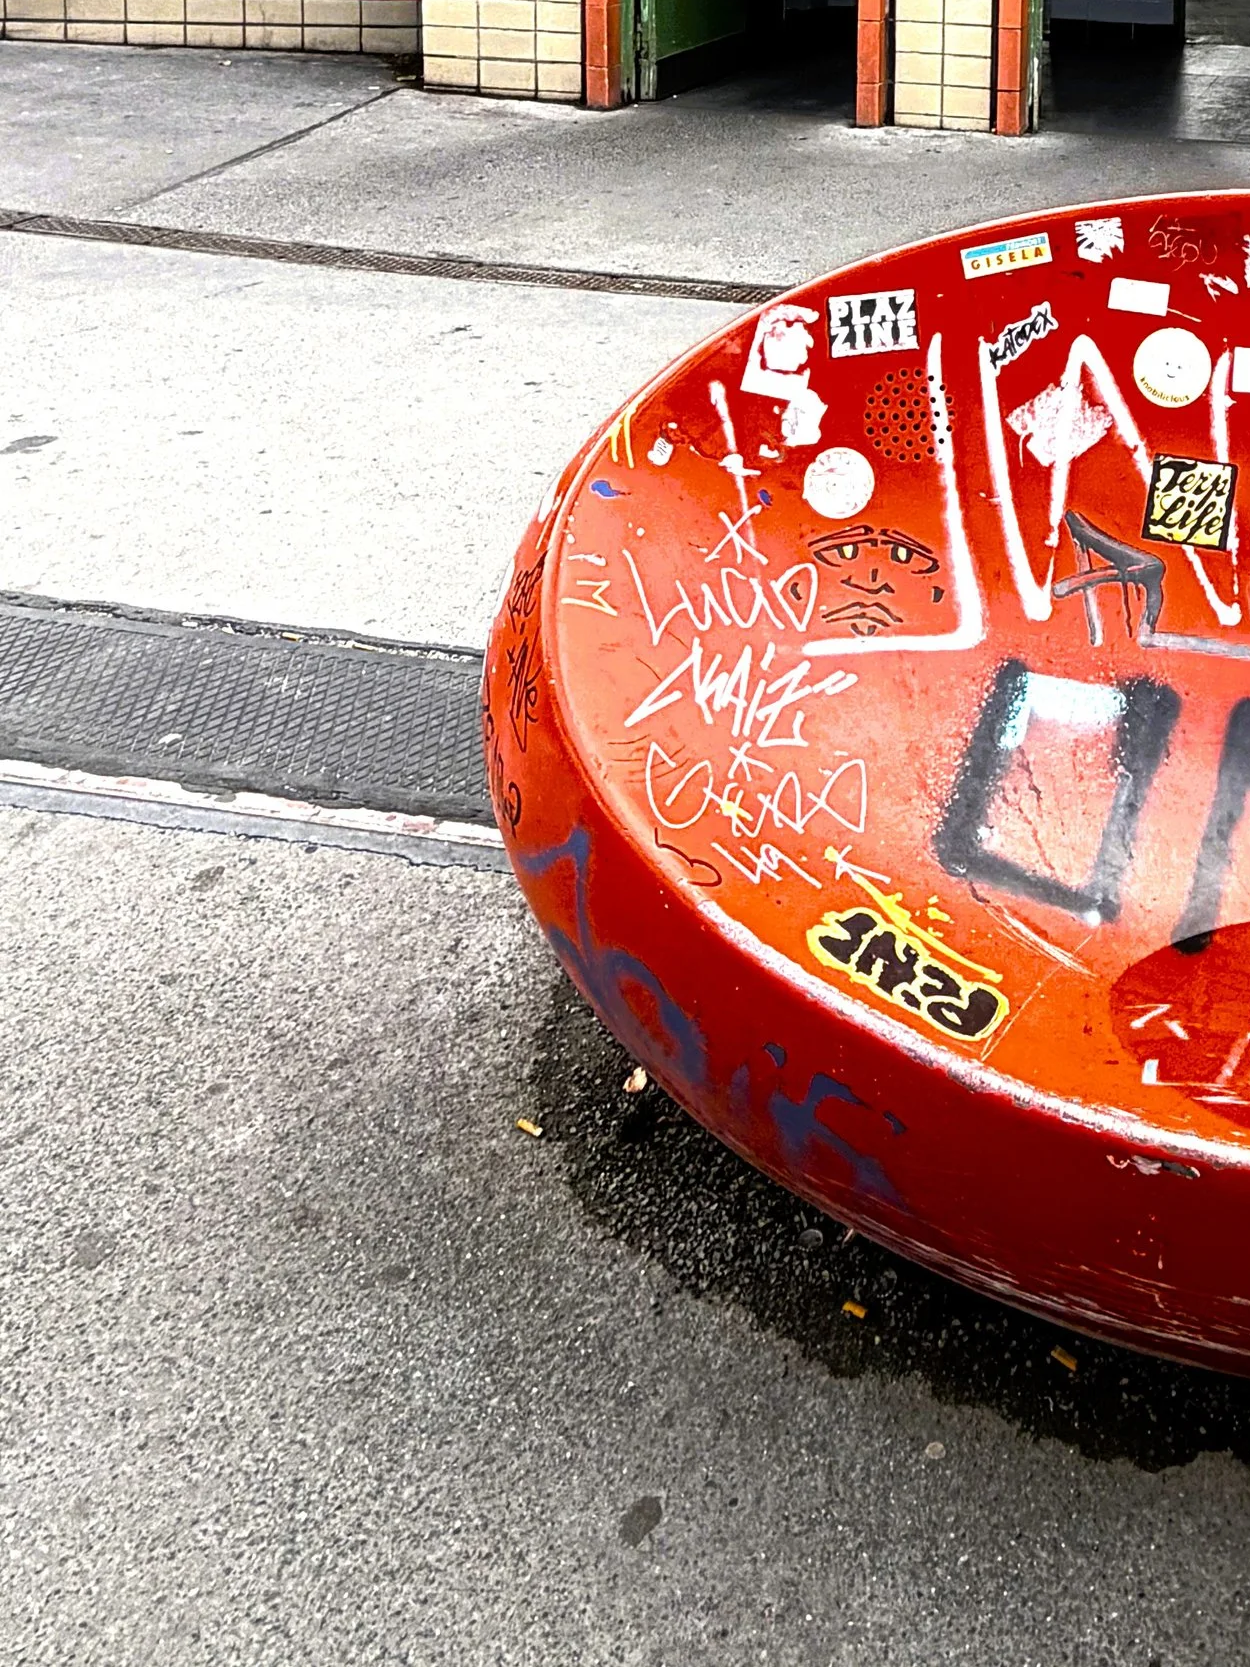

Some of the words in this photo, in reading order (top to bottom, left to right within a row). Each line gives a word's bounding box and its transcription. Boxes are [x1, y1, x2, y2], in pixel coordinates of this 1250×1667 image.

[970, 246, 1044, 271] GISELA
[829, 292, 916, 327] PLAZ
[830, 320, 919, 357] ZINE
[1149, 495, 1224, 543] Life
